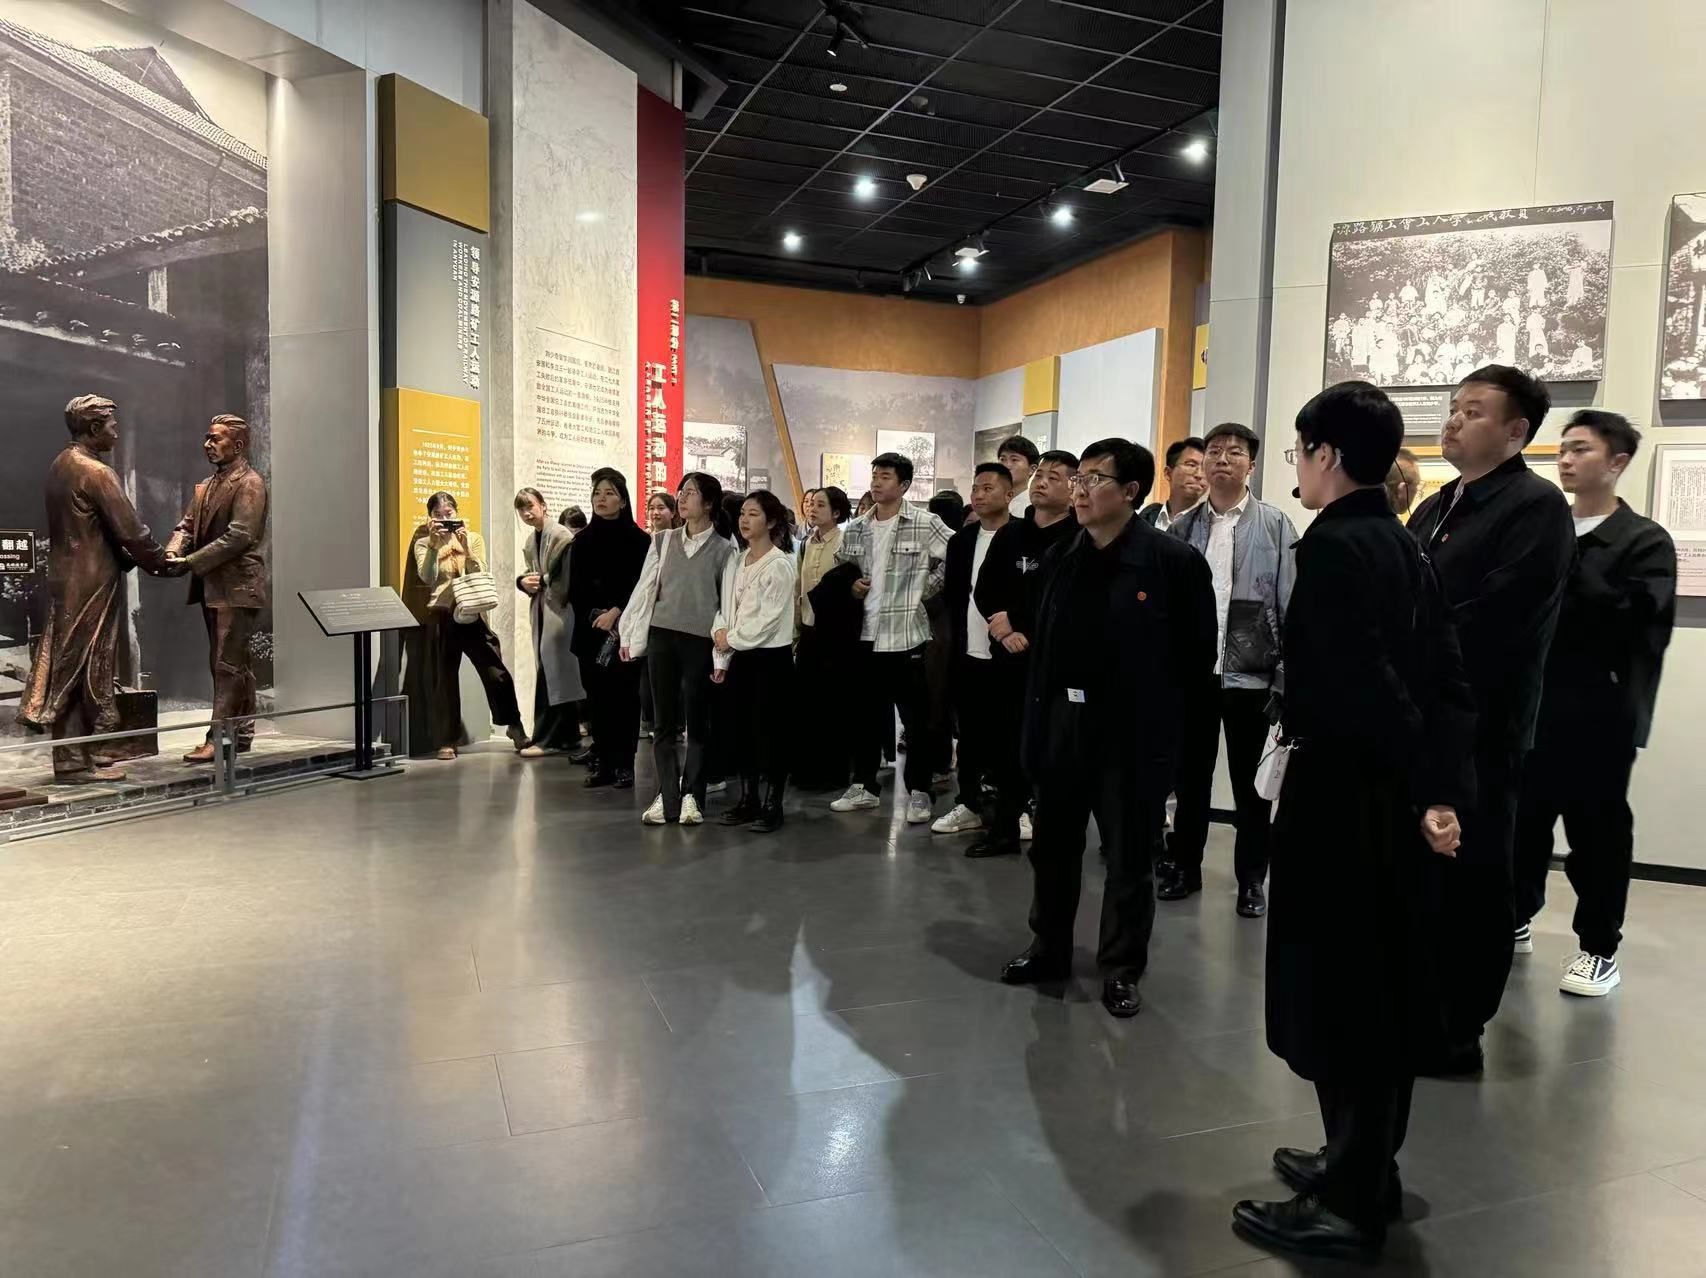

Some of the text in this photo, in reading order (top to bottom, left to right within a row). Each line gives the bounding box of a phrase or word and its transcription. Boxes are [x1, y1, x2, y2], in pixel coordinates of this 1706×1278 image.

[652, 362, 667, 494] 工人运动的
[2, 539, 29, 550] 翻越
